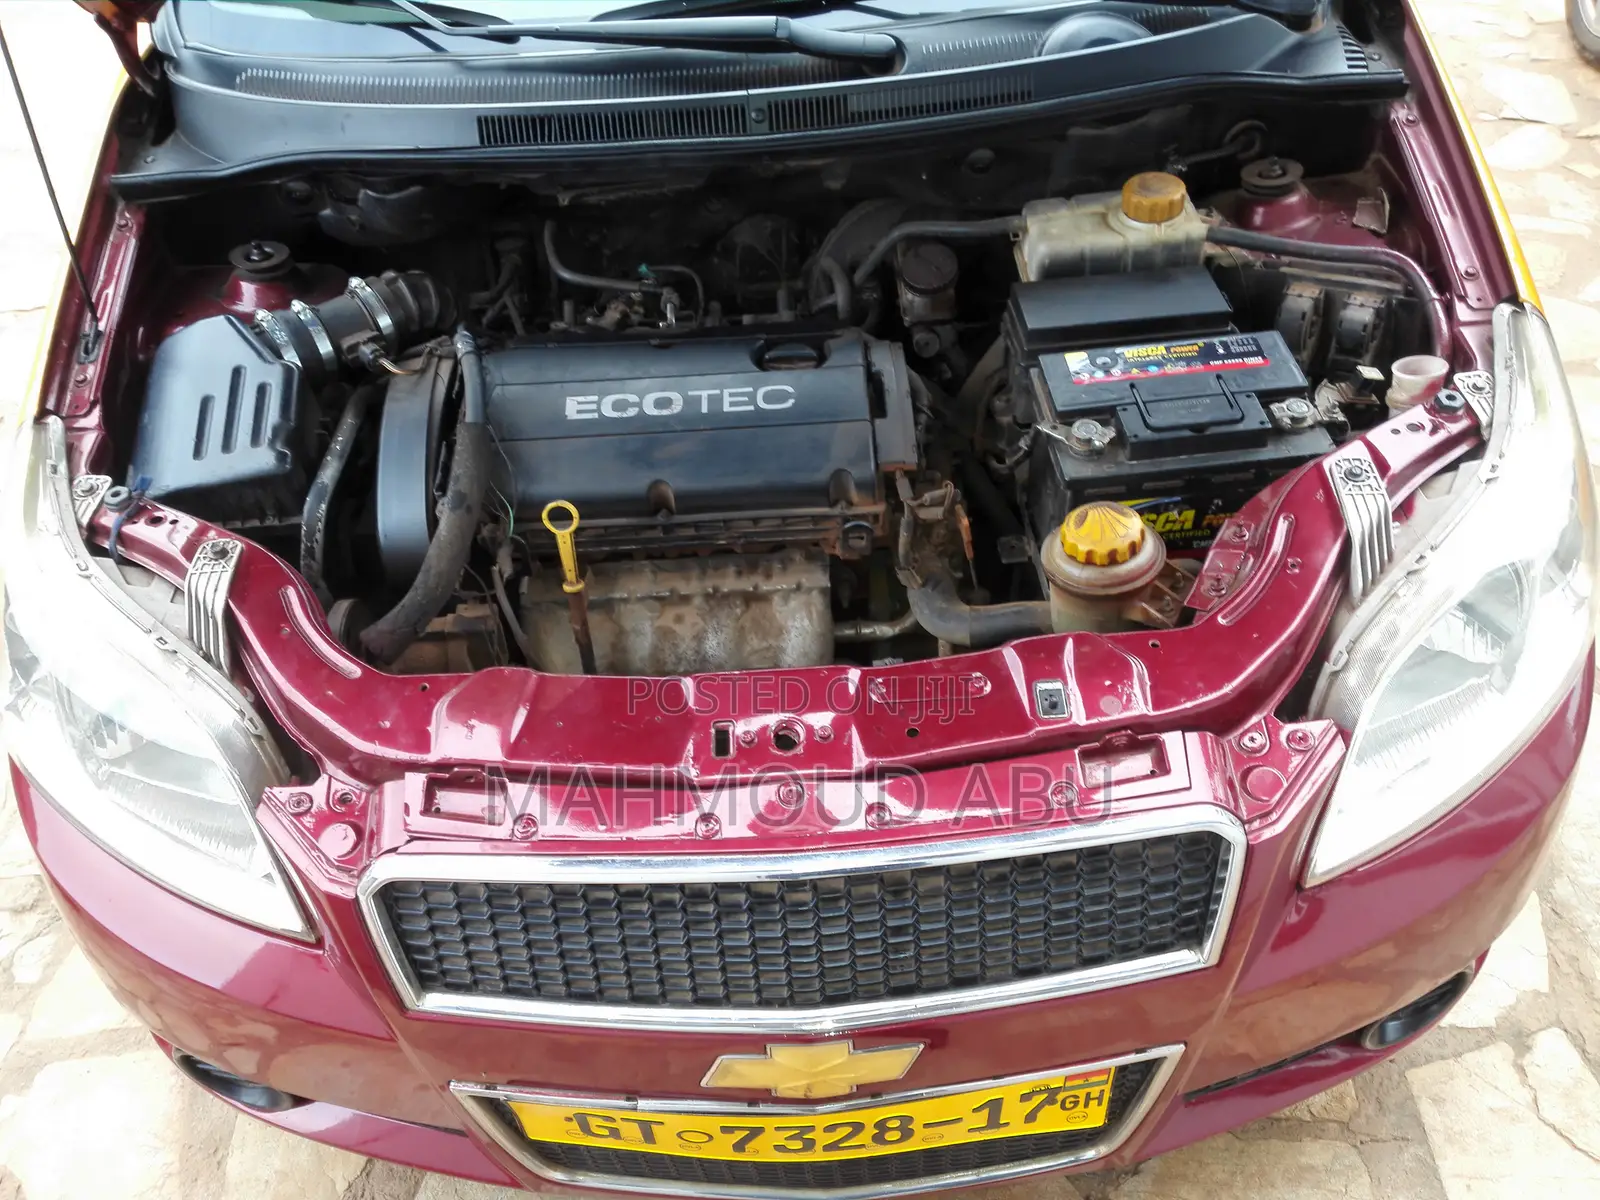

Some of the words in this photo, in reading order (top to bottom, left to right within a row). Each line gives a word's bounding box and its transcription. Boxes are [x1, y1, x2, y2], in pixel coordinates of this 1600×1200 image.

[1123, 345, 1167, 359] VISCA
[564, 384, 797, 421] ECOTEC
[1140, 509, 1196, 533] SCA
[1059, 1089, 1105, 1111] GH
[572, 1111, 665, 1146] GT
[719, 1085, 1063, 1154] 7328-17
